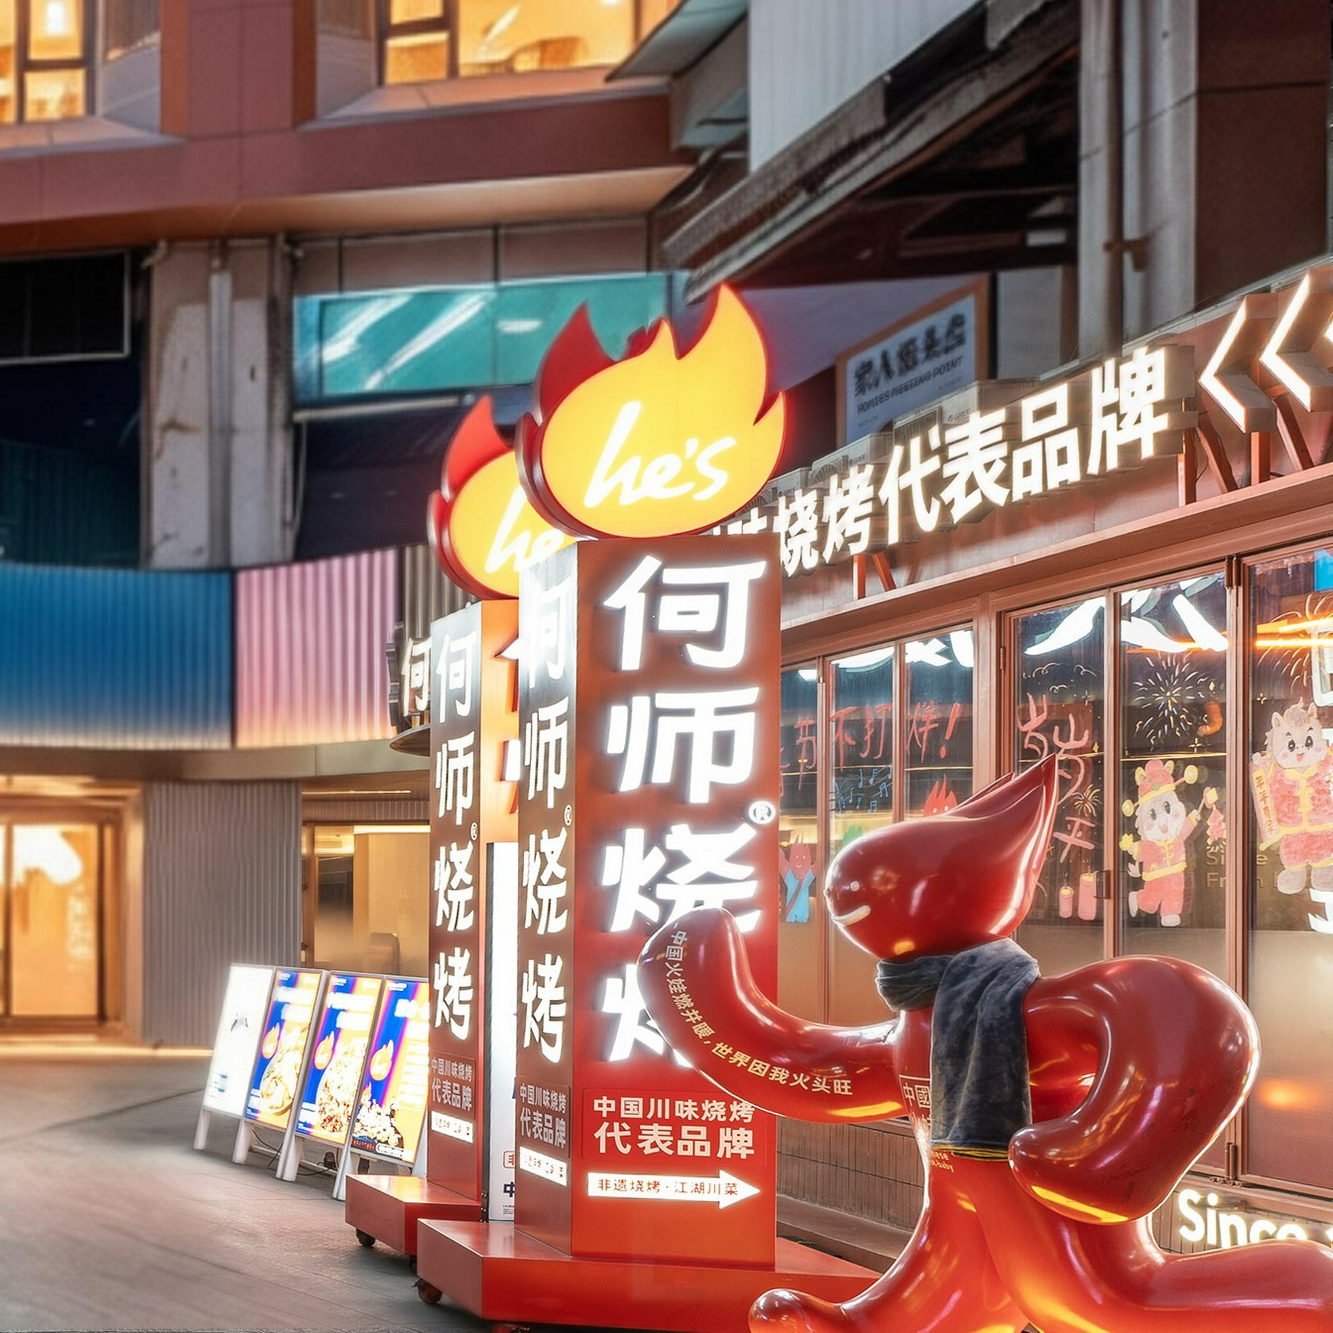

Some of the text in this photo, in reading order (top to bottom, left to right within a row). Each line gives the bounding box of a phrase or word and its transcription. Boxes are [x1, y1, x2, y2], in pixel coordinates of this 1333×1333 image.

[857, 389, 890, 416] HOMIES
[891, 371, 931, 399] MEETING
[933, 355, 964, 380] POINT
[583, 400, 736, 508] he's
[713, 347, 1169, 577] 烧烤代表品牌
[485, 485, 564, 573] he
[780, 700, 961, 791] 节不打烊！
[434, 631, 476, 1041] 何师烧烤
[522, 573, 570, 1064] 何师烧烤
[431, 1077, 472, 1112] 代表品牌
[519, 1083, 567, 1113] 中国川味烧烤
[520, 1108, 567, 1149] 代表品牌
[593, 1096, 755, 1124] 中国川味烧烤
[593, 1121, 755, 1160] 代表品牌
